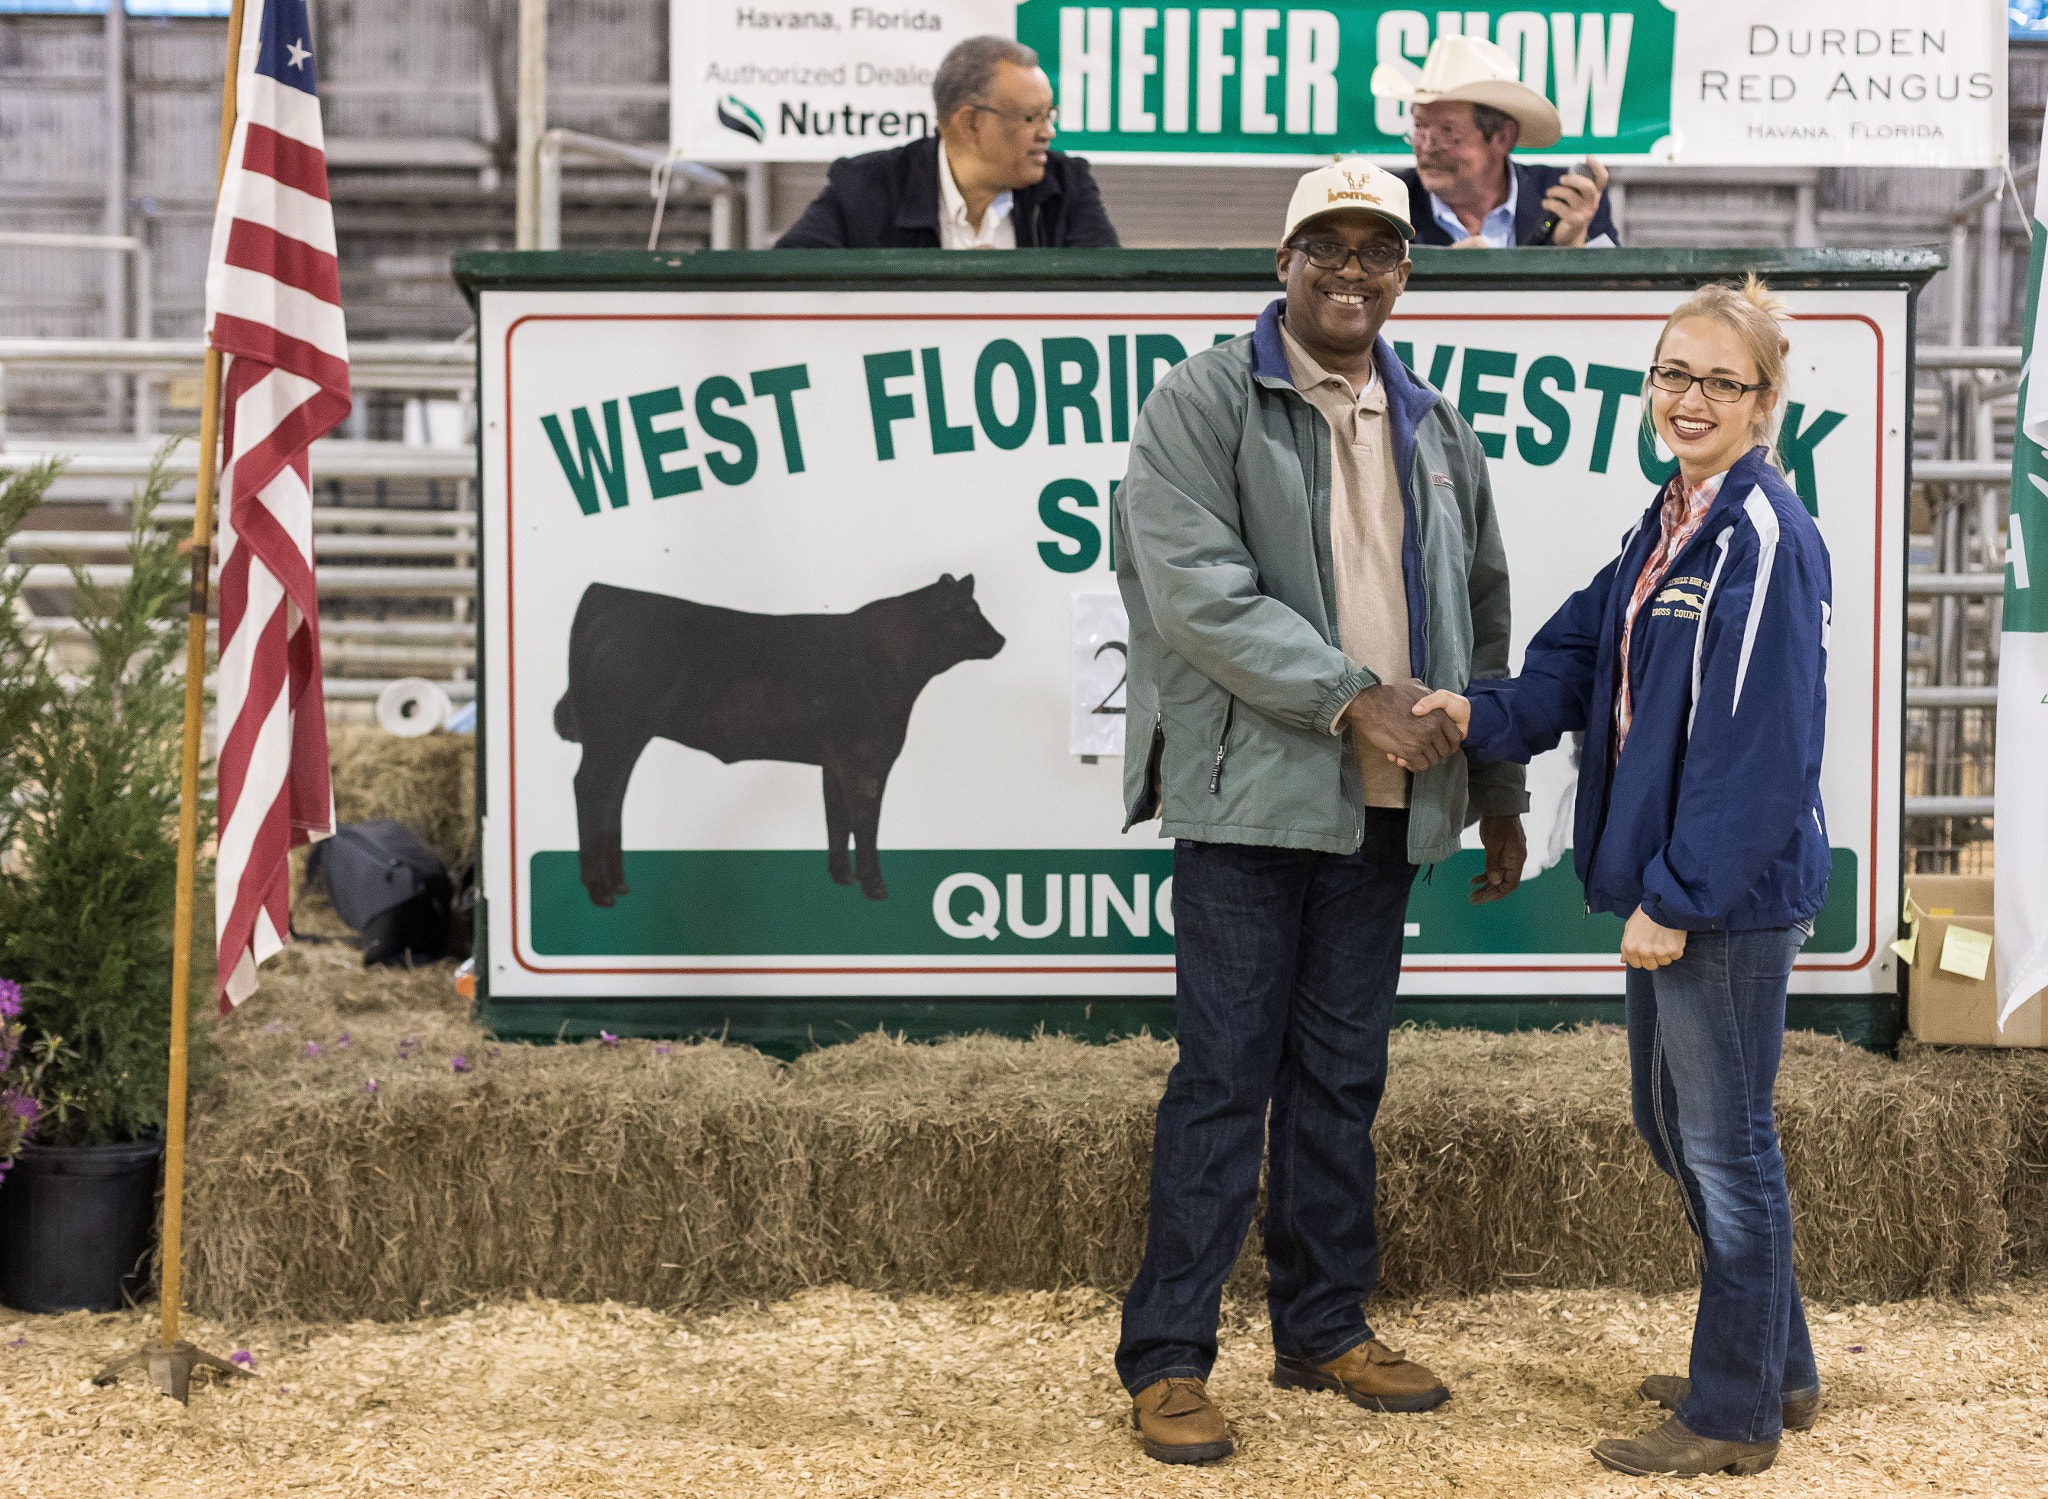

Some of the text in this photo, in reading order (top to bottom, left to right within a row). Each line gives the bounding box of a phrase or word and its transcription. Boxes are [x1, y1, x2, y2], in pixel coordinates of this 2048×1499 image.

[736, 7, 943, 32] Havana, Florida
[1749, 24, 1946, 56] DURDEN
[704, 62, 933, 86] Authorized Deale
[1058, 6, 1635, 138] HEIFER SOW
[1700, 69, 1994, 101] RED ANGUS
[780, 101, 928, 137] Nutren
[1850, 121, 1945, 140] FLORIDA
[539, 363, 811, 517] WEST
[1674, 608, 1701, 620] COUNT
[932, 871, 1176, 942] QUIN
